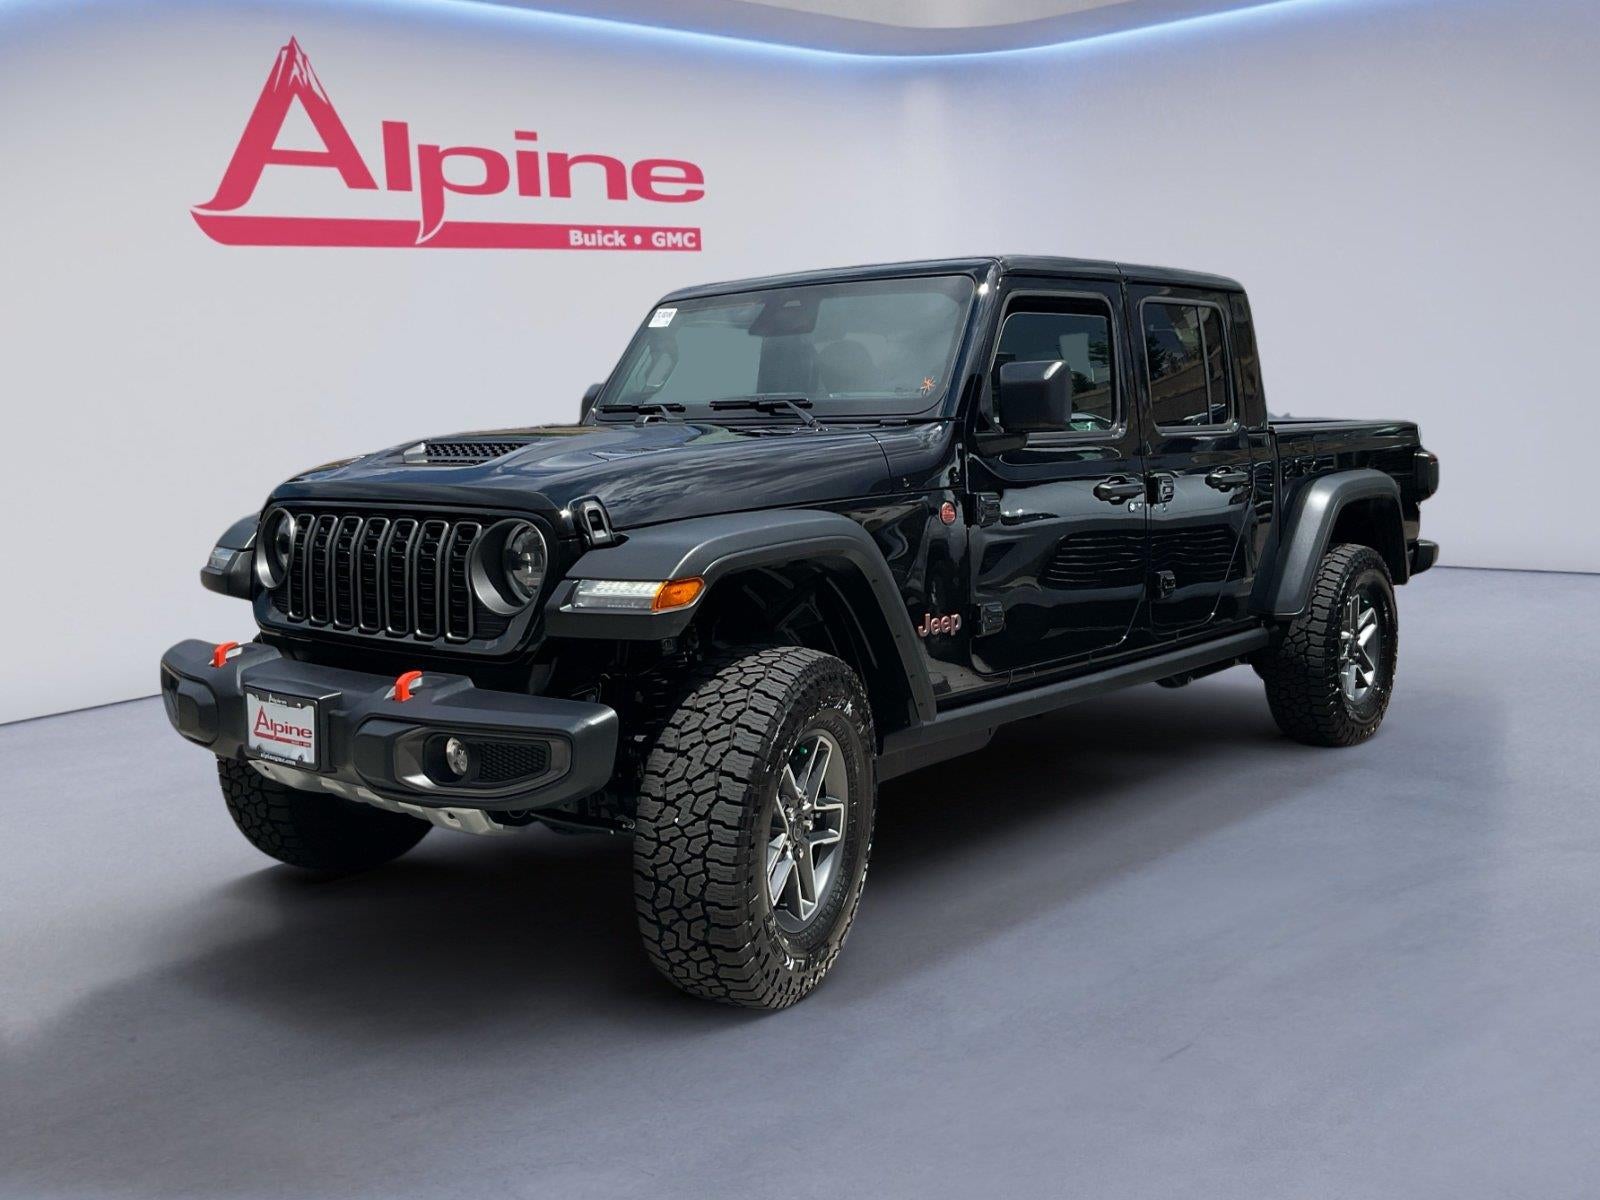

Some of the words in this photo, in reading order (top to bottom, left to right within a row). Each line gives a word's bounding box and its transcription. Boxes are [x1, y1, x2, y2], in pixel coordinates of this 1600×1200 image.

[191, 36, 705, 244] Alpine
[568, 229, 627, 247] Buick
[651, 231, 697, 248] GMC
[917, 613, 962, 637] Jeep
[253, 705, 313, 740] Alpine
